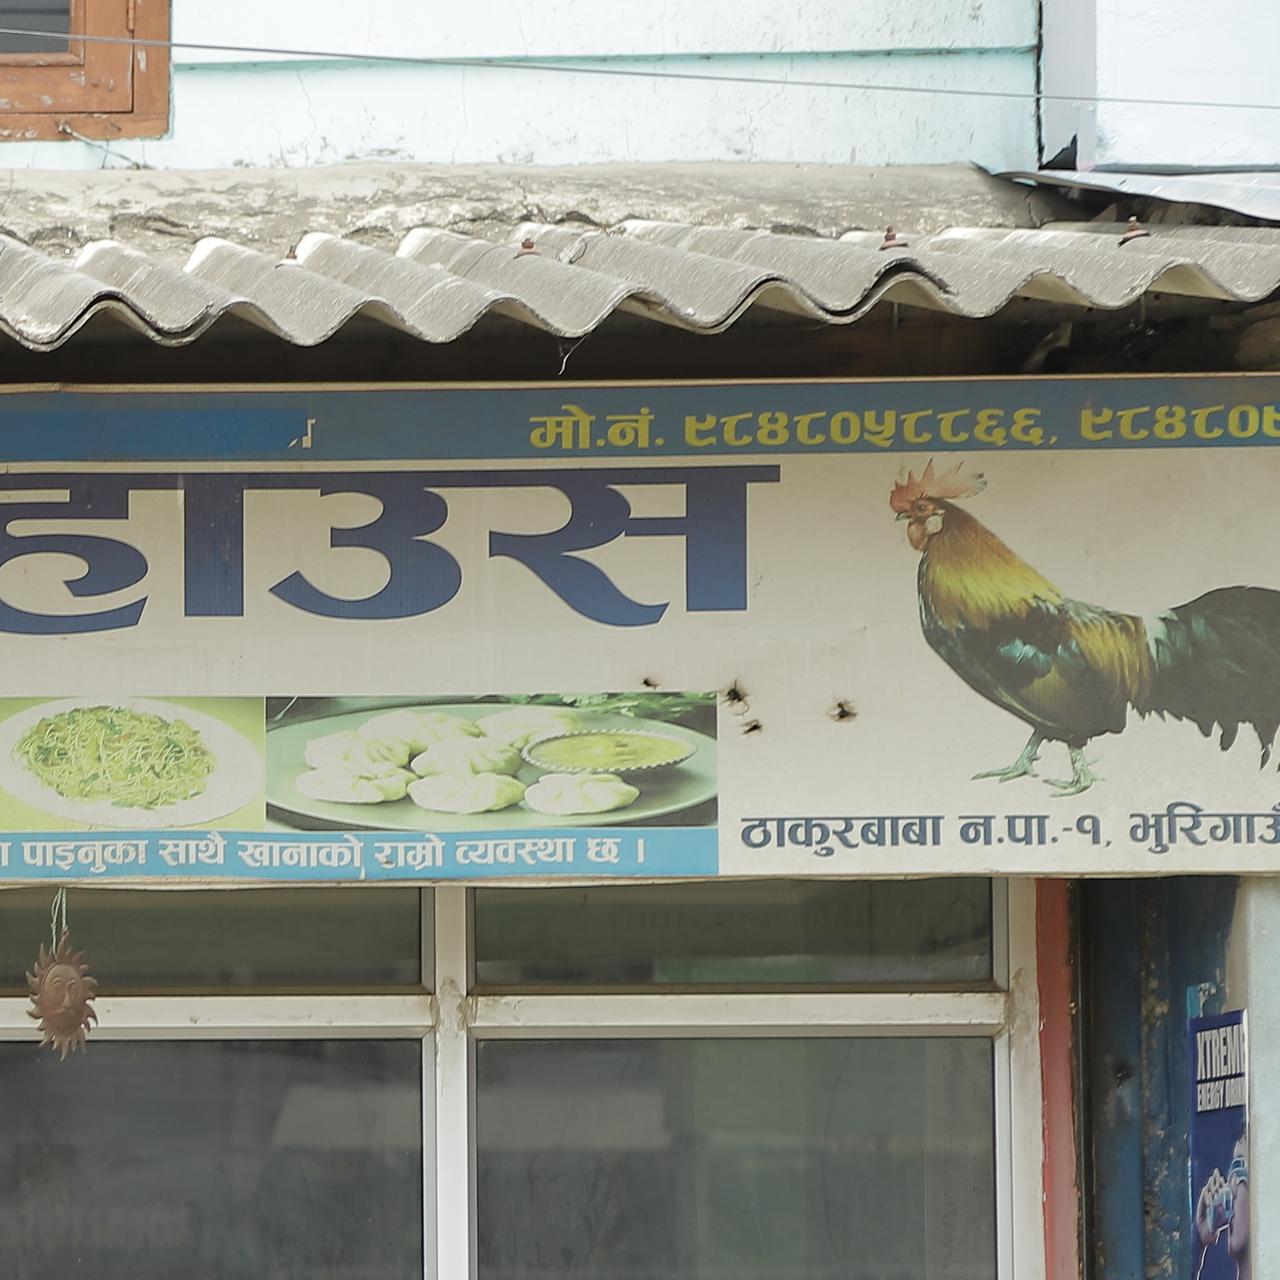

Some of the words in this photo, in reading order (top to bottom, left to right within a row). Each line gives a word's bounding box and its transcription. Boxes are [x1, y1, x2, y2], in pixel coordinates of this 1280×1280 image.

[158, 831, 228, 866] साथै
[237, 834, 364, 870] खानाको
[374, 834, 446, 871] राम्रो
[455, 836, 577, 866] व्यवस्था
[587, 837, 622, 864] छ
[740, 814, 946, 857] ठाकुरबाबा
